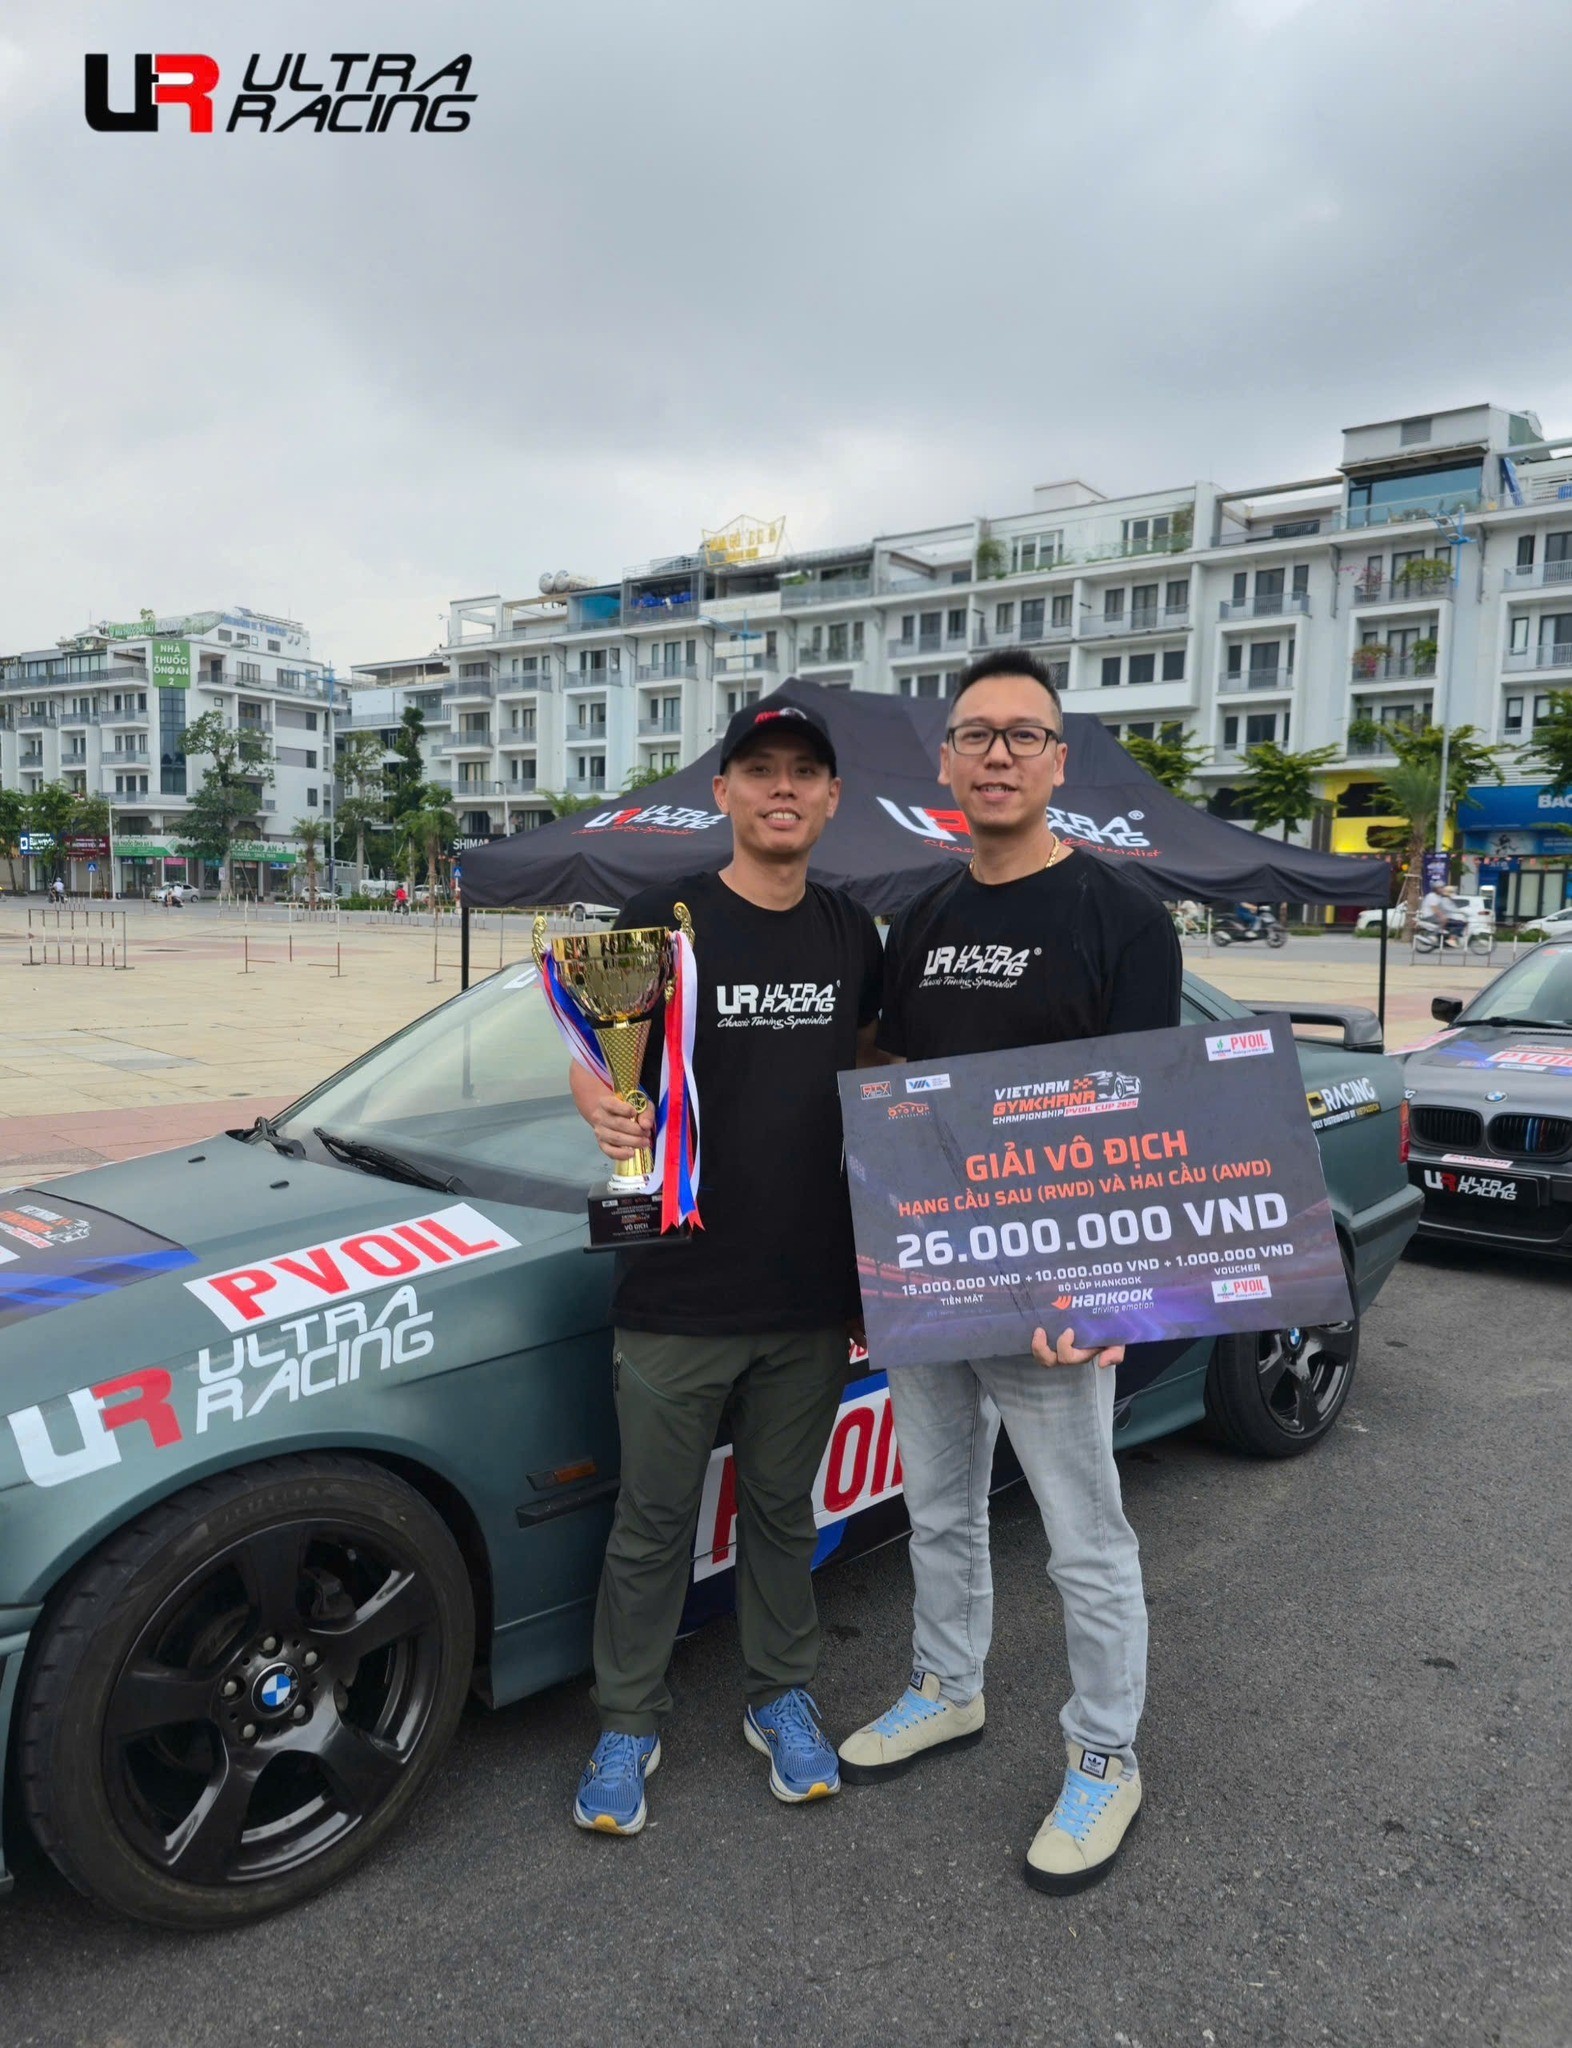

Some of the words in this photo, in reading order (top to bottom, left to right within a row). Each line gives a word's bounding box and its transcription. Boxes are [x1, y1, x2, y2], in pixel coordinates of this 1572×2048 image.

[160, 644, 181, 653] NHÀ
[154, 653, 188, 665] THUỐC
[168, 677, 175, 686] 2
[640, 805, 728, 824] ULTRA
[1048, 821, 1150, 847] ACING
[453, 838, 489, 850] SHIMA
[959, 944, 1030, 963] ULTRA
[952, 958, 1028, 977] RACING
[765, 983, 834, 999] ULTRA
[759, 997, 836, 1013] RACING
[784, 1013, 833, 1029] Specialist
[1230, 1033, 1268, 1050] PVOIL
[994, 1080, 1070, 1100] VIETNAM
[1320, 1077, 1376, 1111] RACING
[992, 1090, 1096, 1116] GYMKHANA
[992, 1109, 1064, 1125] CHAMPIONSHIP
[1065, 1106, 1093, 1115] PVOIL
[1095, 1103, 1115, 1111] CUP
[965, 1141, 1036, 1181] GIẢI
[1043, 1135, 1094, 1172] VÔ
[1103, 1129, 1188, 1170] ĐỊCH
[898, 1197, 949, 1221] HẠNG
[954, 1187, 988, 1211] CẦU
[994, 1189, 1032, 1205] SAU
[1037, 1179, 1094, 1203] (RWD)
[1100, 1172, 1126, 1194] VÀ
[1130, 1173, 1164, 1191] HAI
[1168, 1161, 1207, 1184] CẦU
[1212, 1158, 1272, 1184] (AWD)
[1457, 1184, 1518, 1201] RACING
[1459, 1175, 1516, 1191] ULTRA
[896, 1205, 1173, 1270] 26.000.000
[1182, 1192, 1289, 1237] VND
[207, 1219, 501, 1321] PVOIL
[901, 1276, 986, 1297] 15.000.000
[988, 1272, 1021, 1287] VND
[1034, 1262, 1123, 1283] 10.000.000
[1126, 1257, 1160, 1272] VND
[1164, 1259, 1171, 1267] +
[1175, 1247, 1256, 1267] 1.000.000
[1258, 1243, 1293, 1258] VND
[1214, 1263, 1261, 1276] VOUCHER
[1058, 1281, 1072, 1293] BỘ
[1094, 1276, 1142, 1288] HANKOOK
[1233, 1279, 1267, 1293] PVOIL
[940, 1293, 962, 1306] TIỀN
[964, 1292, 984, 1304] MẶT
[1092, 1304, 1120, 1315] driving
[1121, 1301, 1155, 1311] emotion
[197, 1285, 418, 1386] ULTRA
[195, 1311, 434, 1435] RACING
[6, 1367, 183, 1488] UR
